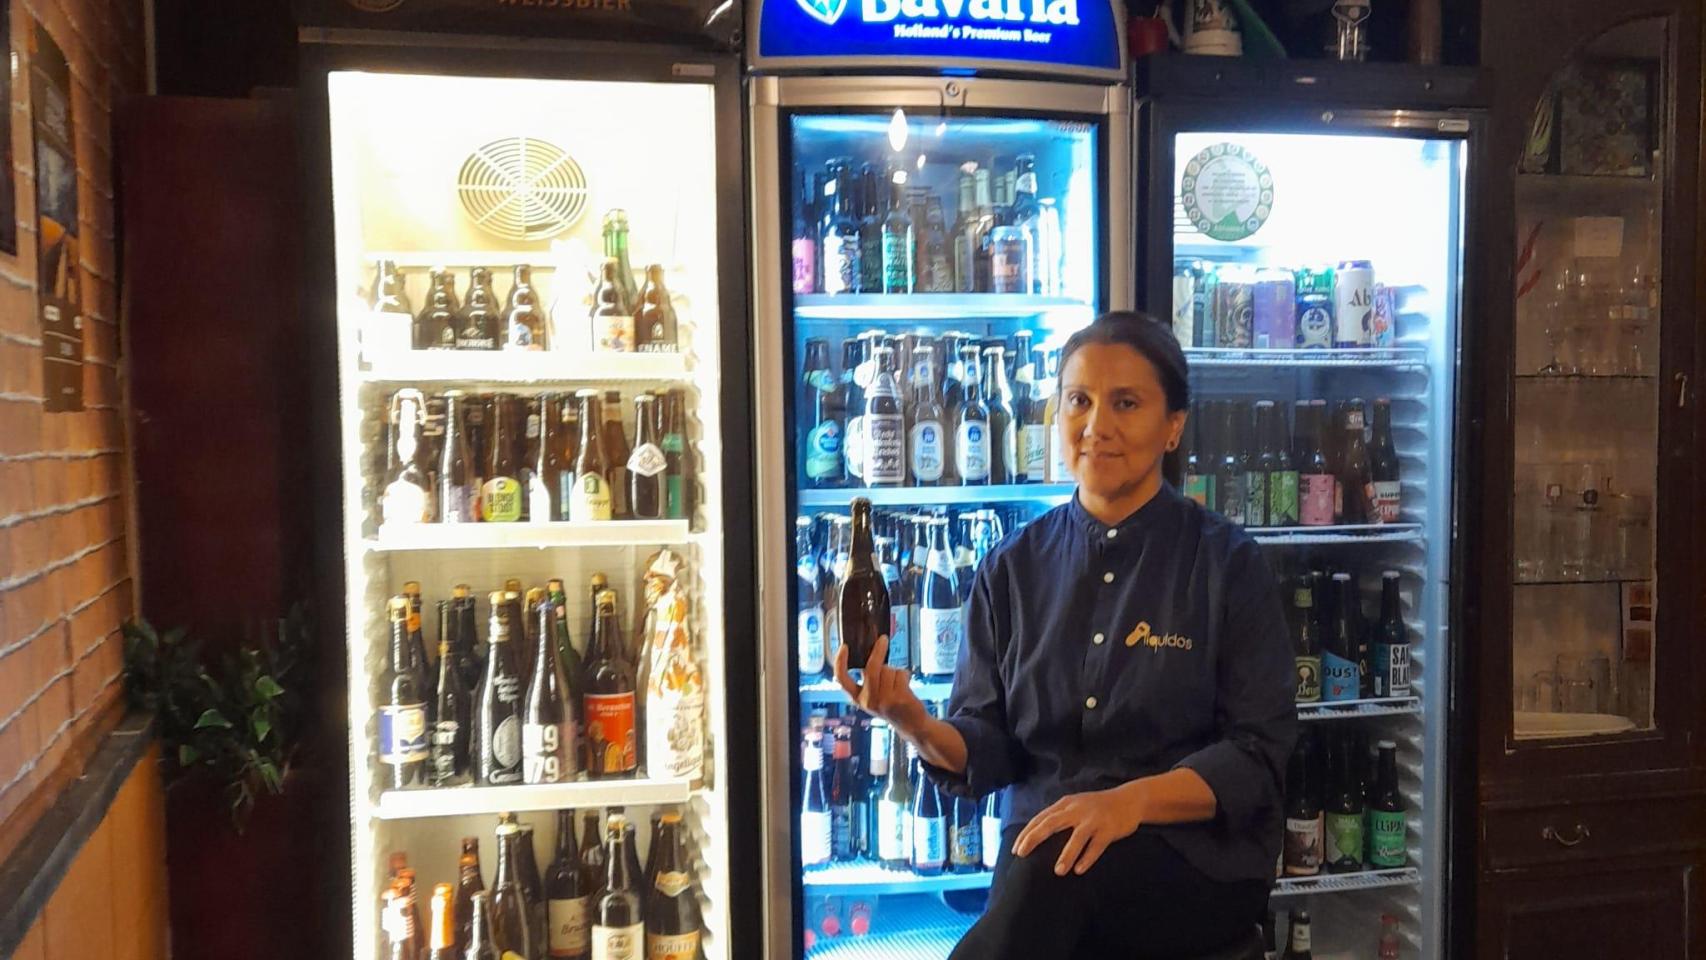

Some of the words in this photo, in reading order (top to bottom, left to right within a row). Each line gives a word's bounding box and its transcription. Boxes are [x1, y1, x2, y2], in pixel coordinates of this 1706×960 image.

[893, 24, 961, 39] Holland's
[962, 26, 1022, 41] Premium
[1023, 28, 1052, 43] Beer
